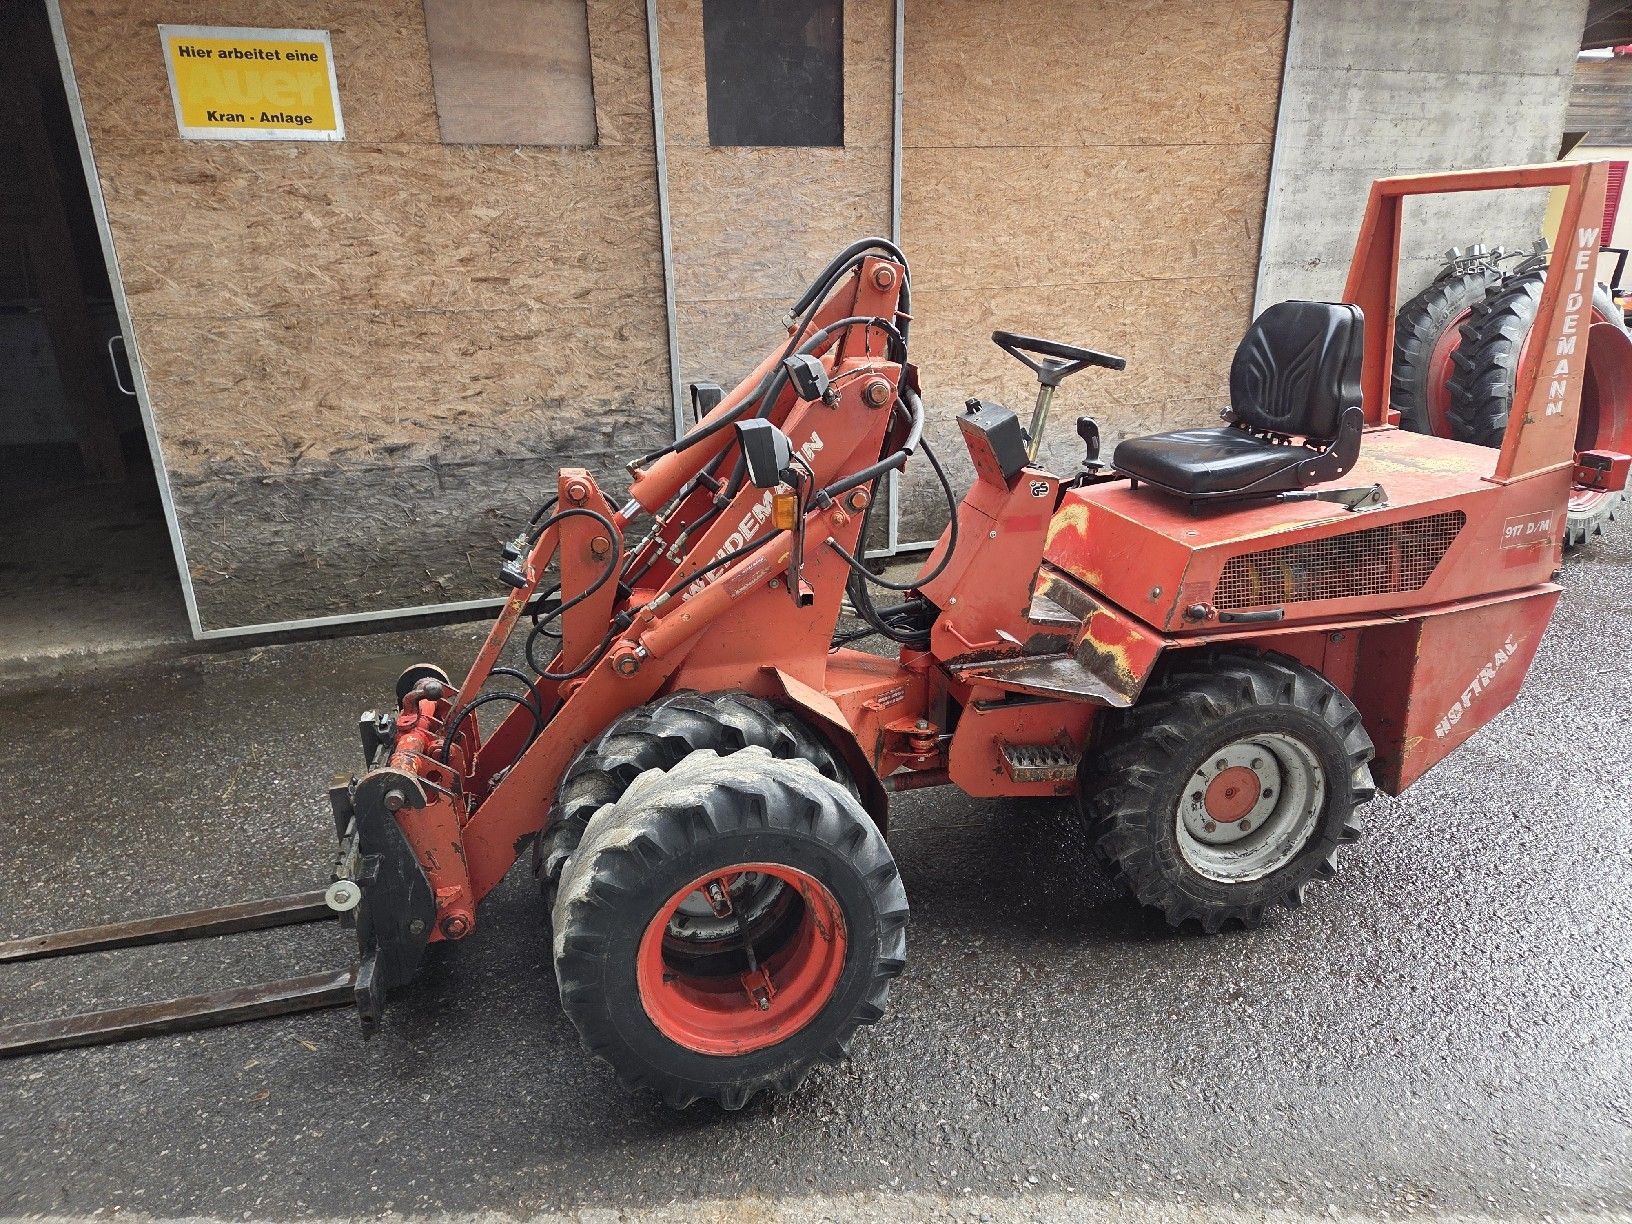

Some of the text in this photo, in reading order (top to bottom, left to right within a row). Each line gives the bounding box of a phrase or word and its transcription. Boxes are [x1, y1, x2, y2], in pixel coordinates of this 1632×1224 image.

[178, 45, 319, 62] Hier arbeitet eine
[187, 64, 323, 107] Auer
[206, 110, 245, 123] Kran
[259, 111, 313, 126] Anlage
[1545, 227, 1600, 416] WEIDEMANN
[1504, 524, 1524, 539] 917
